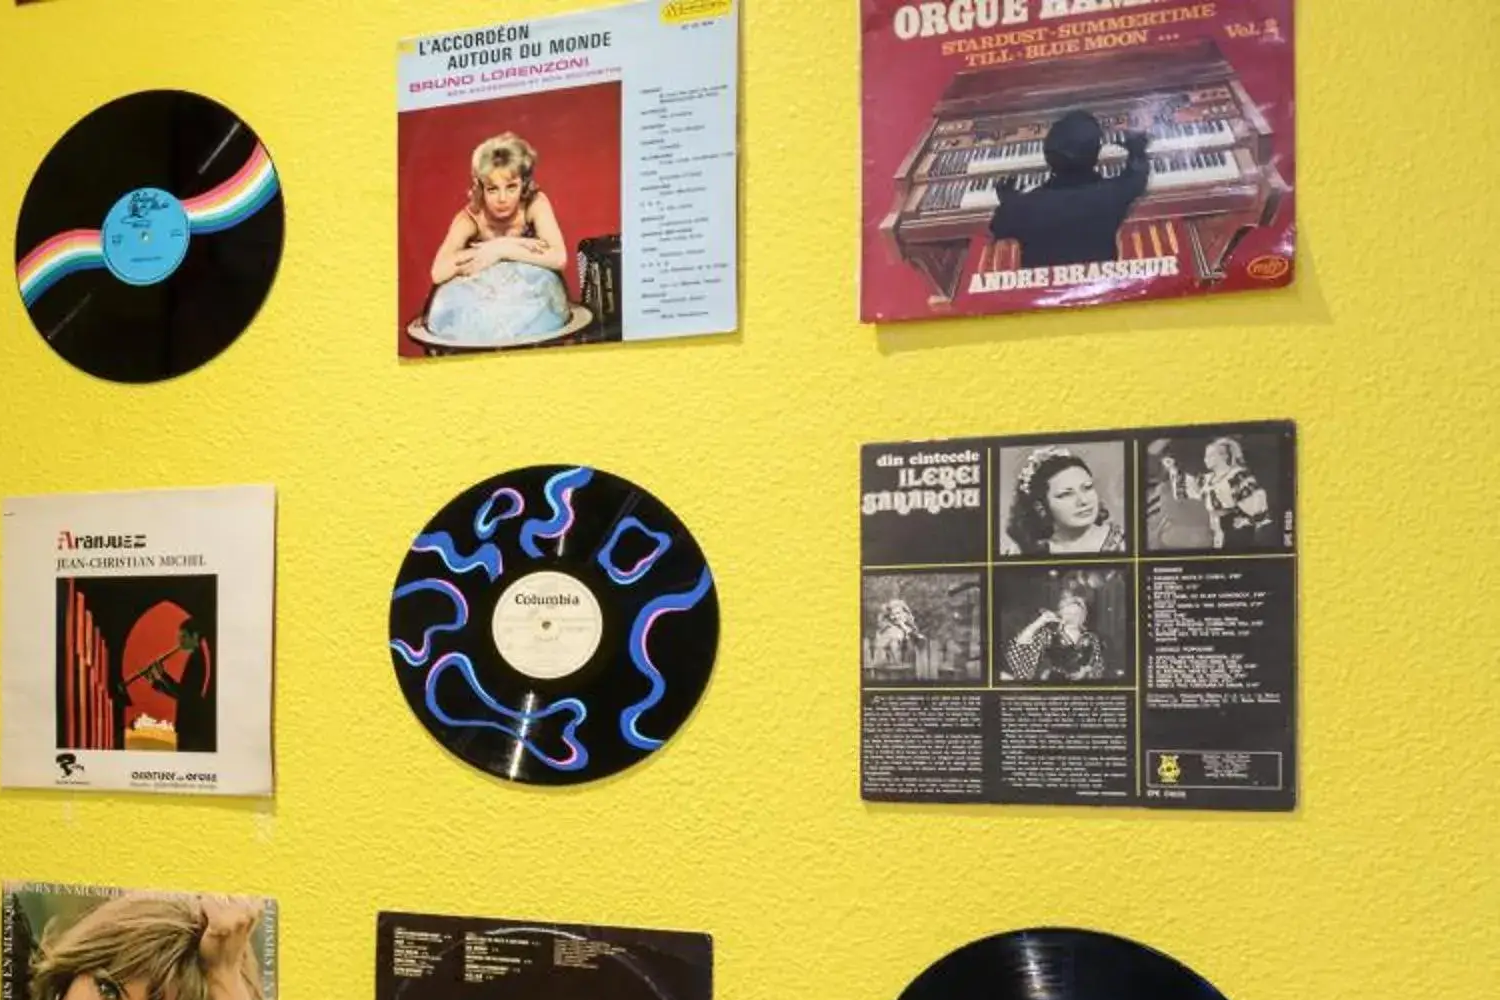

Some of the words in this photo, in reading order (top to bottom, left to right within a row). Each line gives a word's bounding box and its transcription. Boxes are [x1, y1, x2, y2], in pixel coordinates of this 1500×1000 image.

[894, 0, 1029, 40] ORGUE
[447, 47, 513, 71] AUTOUR
[519, 42, 542, 59] DU
[549, 31, 612, 55] MONDE
[942, 26, 1049, 56] STARDUST
[1084, 29, 1149, 51] MOON
[409, 72, 474, 93] BRUNO
[481, 56, 590, 83] LORENZONI
[1053, 256, 1179, 285] BRASSEUR
[876, 453, 904, 467] din
[515, 593, 580, 606] Columbia
